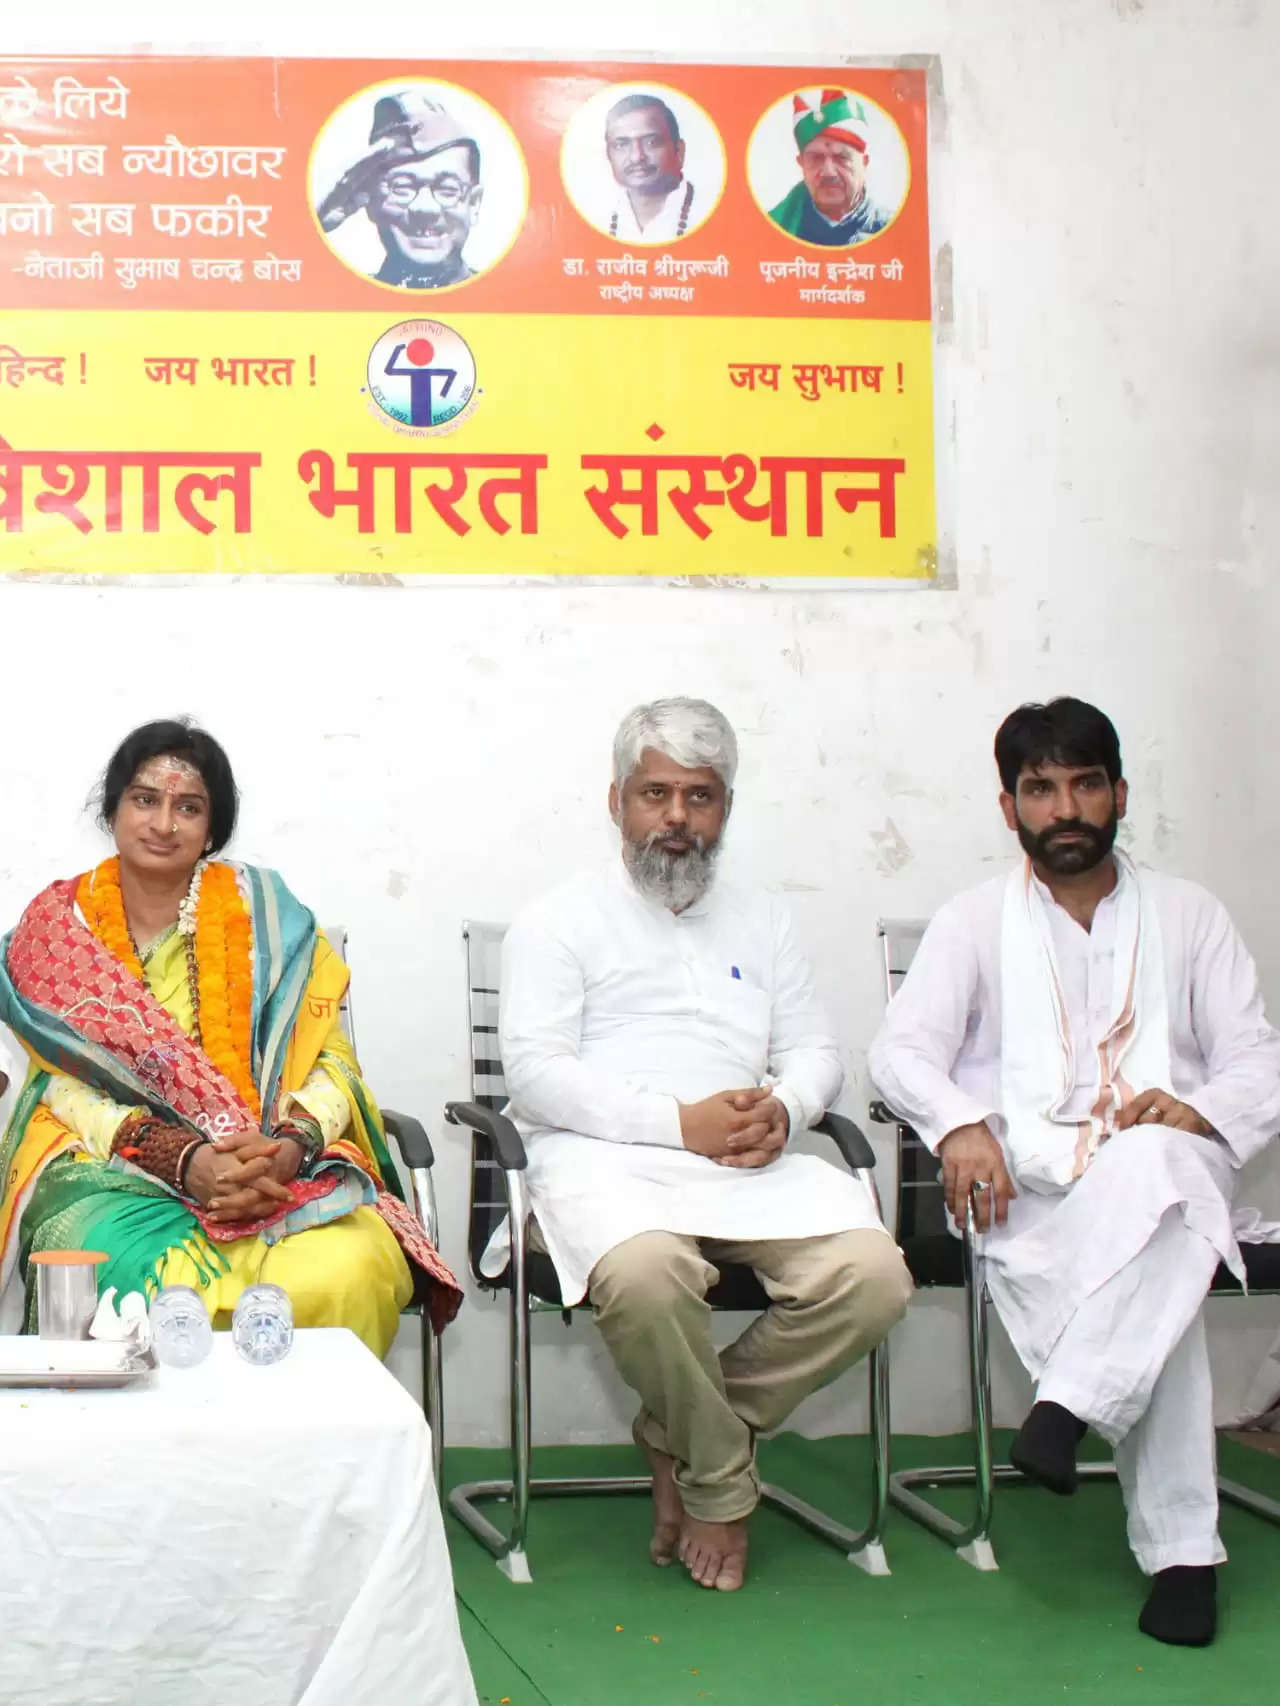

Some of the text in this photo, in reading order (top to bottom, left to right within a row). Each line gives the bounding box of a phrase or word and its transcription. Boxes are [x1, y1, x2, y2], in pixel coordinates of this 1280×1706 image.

[54, 77, 129, 119] लिये
[44, 144, 108, 178] सब
[123, 136, 286, 179] न्यौछावर
[71, 203, 136, 237] सब
[151, 194, 272, 238] फकीर
[191, 258, 244, 283] चन्द्र
[253, 252, 302, 281] बोस
[596, 254, 647, 276] राजीव
[759, 256, 820, 282] पूजनीय
[881, 258, 904, 281] जी
[600, 281, 694, 303] राष्ट्रीय अध्यक्ष
[144, 357, 199, 386] जय
[211, 357, 295, 386] भारत
[728, 363, 781, 391] जय
[792, 364, 883, 401] सुभाष
[298, 450, 548, 538] भारत
[582, 425, 905, 542] संस्थान
